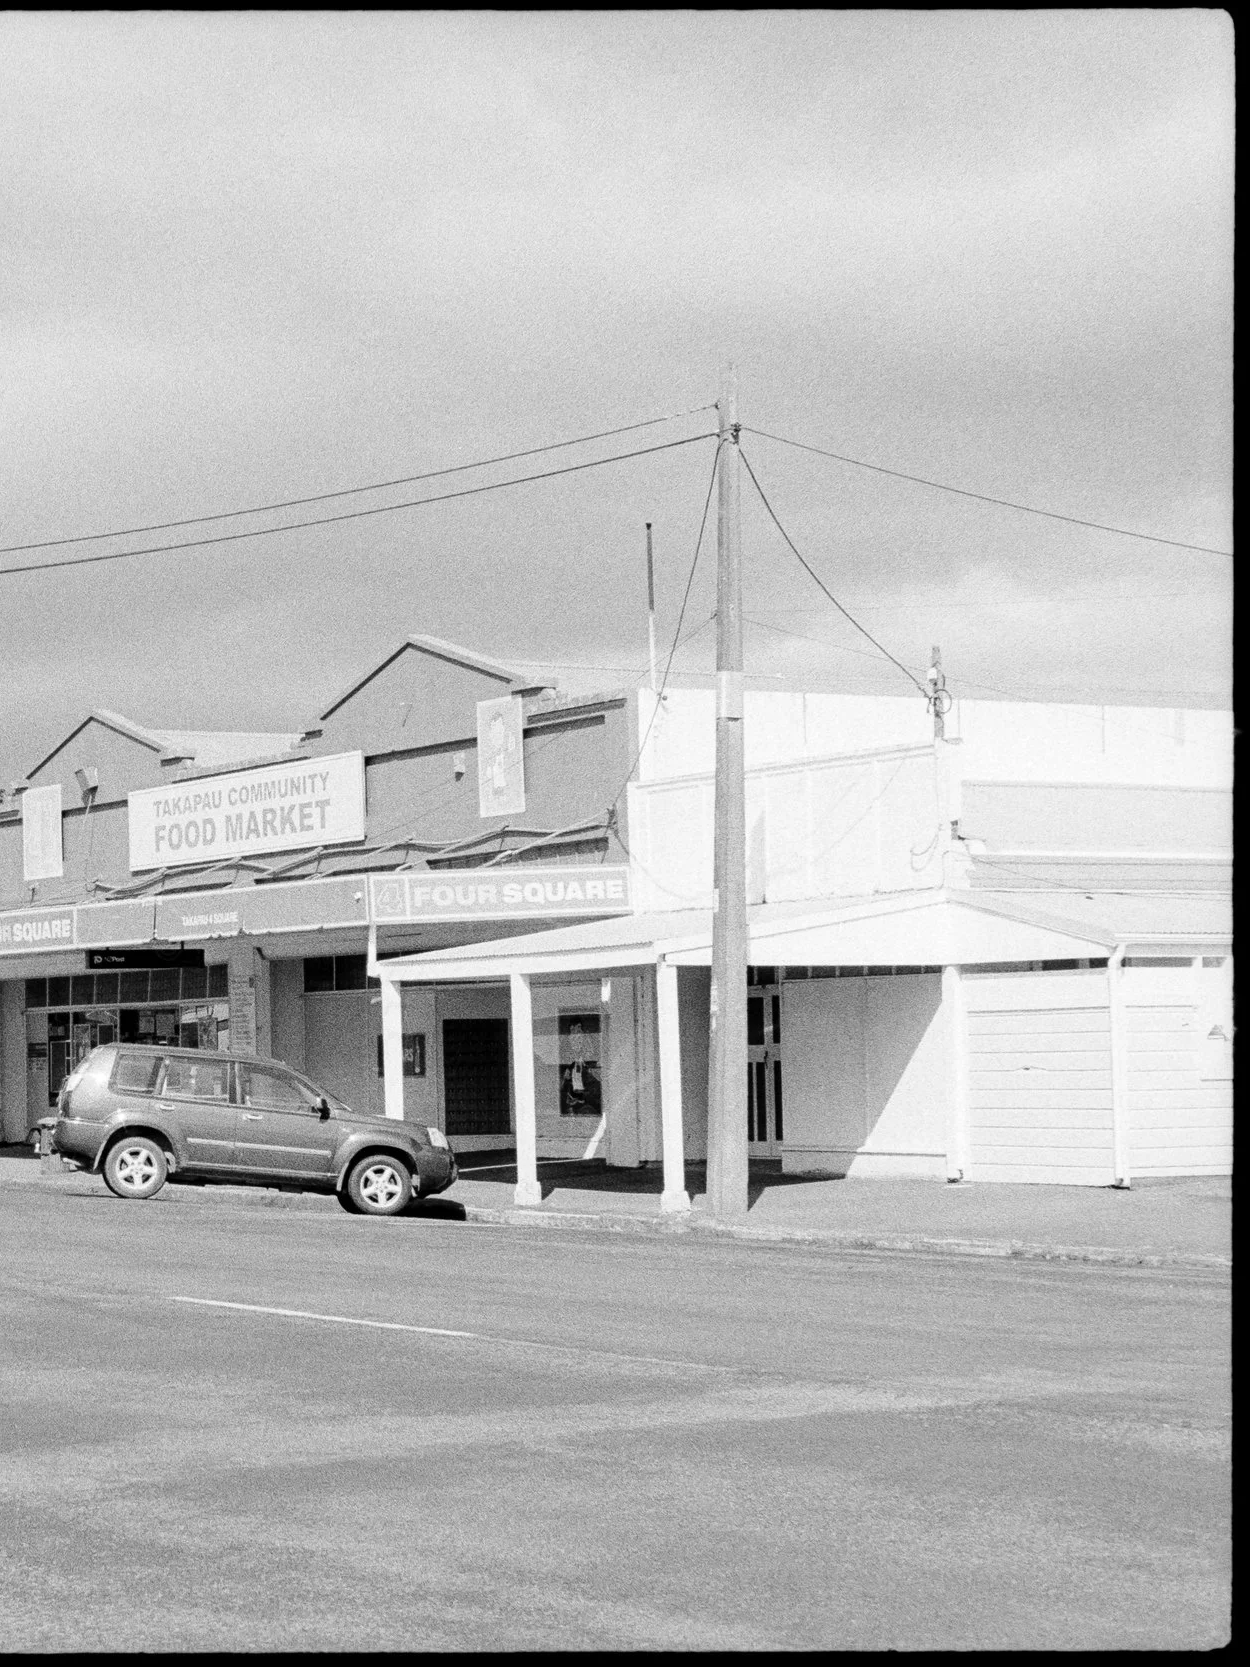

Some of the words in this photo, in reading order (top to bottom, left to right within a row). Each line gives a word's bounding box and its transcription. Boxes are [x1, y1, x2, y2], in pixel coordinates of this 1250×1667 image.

[153, 790, 222, 818] TAKAPAU
[228, 771, 330, 807] COMMUNITY
[154, 817, 217, 853] FOOD
[225, 798, 331, 842] MARKET
[413, 883, 498, 908] FOUR
[502, 879, 624, 905] SQUARE
[12, 918, 71, 942] SQUARE
